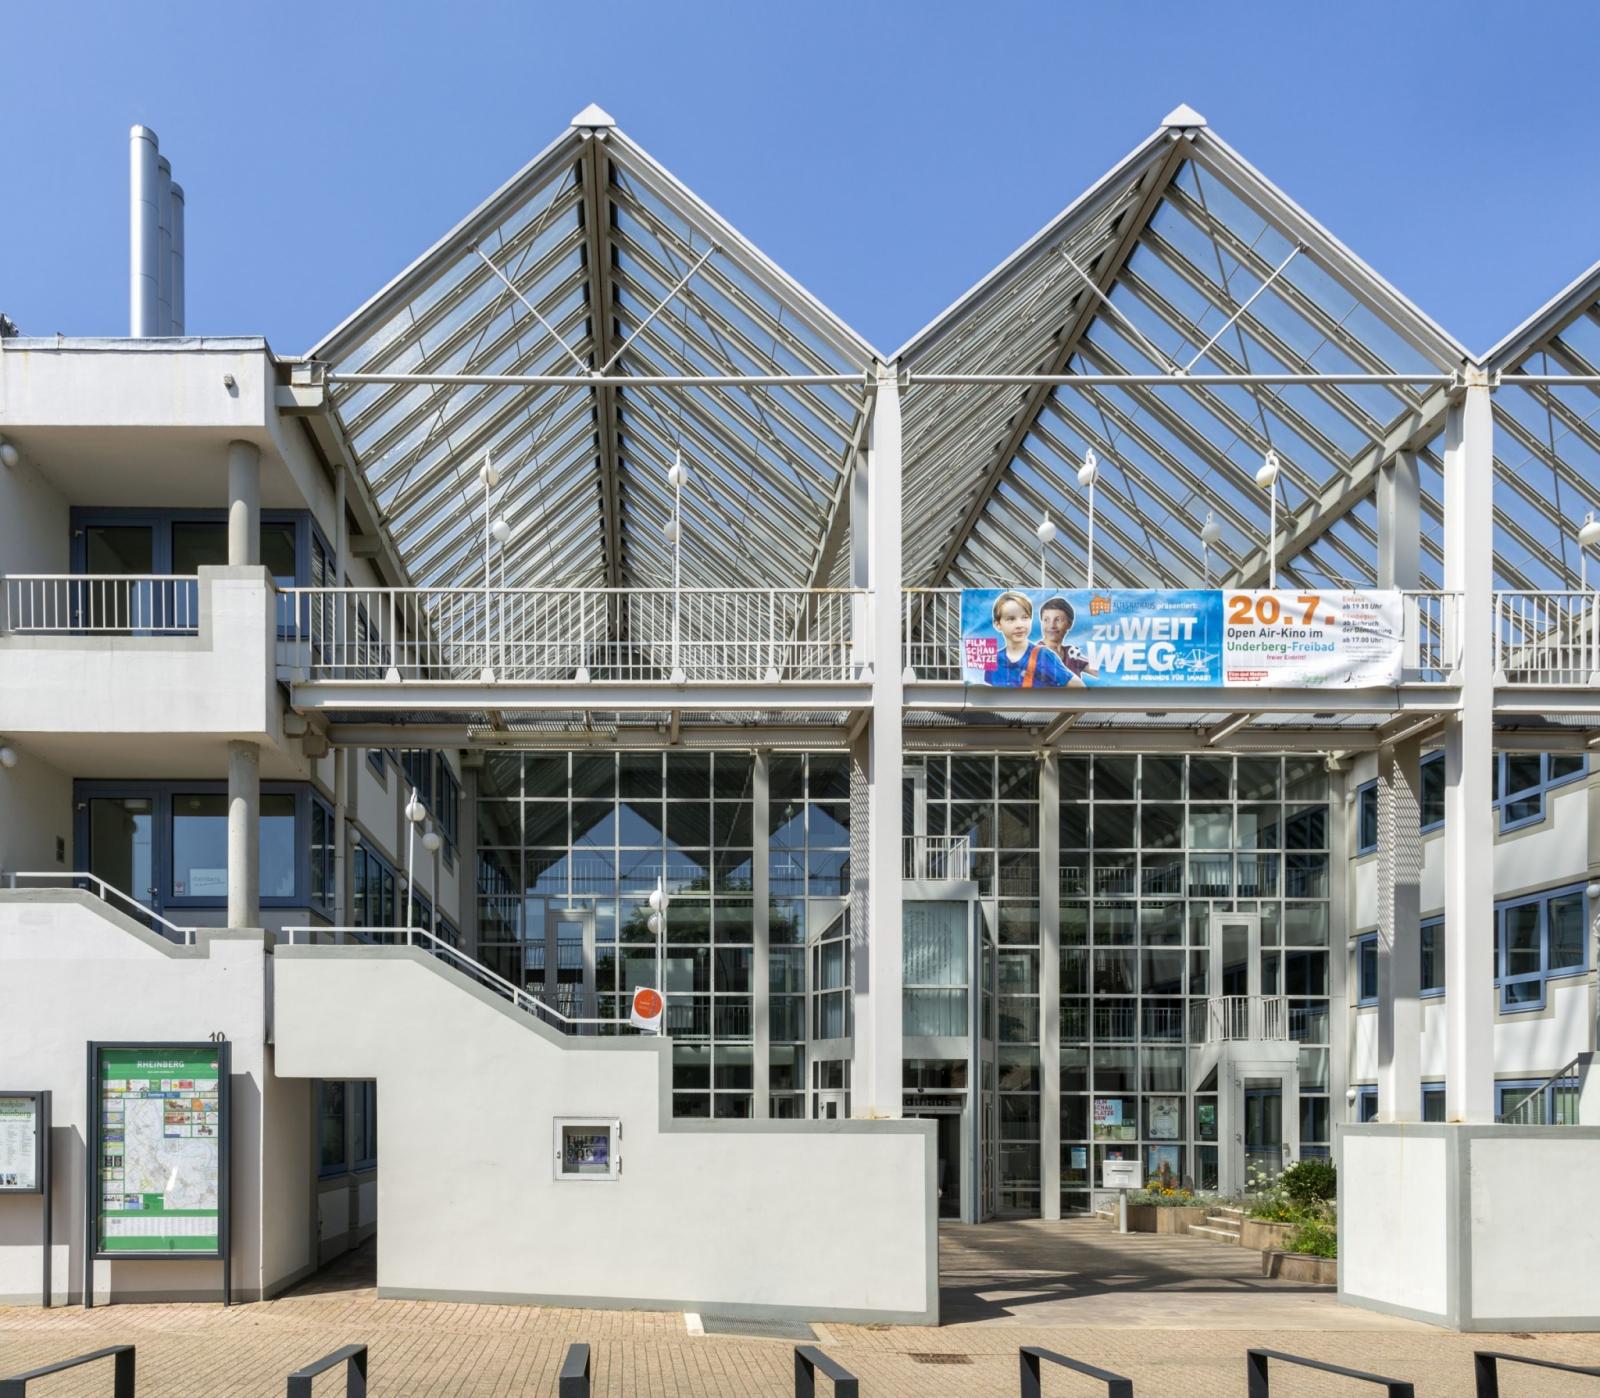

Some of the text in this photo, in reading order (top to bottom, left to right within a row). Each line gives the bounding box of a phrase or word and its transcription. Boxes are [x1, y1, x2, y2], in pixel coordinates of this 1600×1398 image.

[1228, 595, 1335, 625] 20.7.
[1120, 617, 1198, 640] WEIT
[1227, 628, 1323, 640] Open Air-Kino im
[966, 639, 986, 647] FILM
[1227, 642, 1335, 653] Underberg-Freibad
[966, 647, 994, 655] SCHAU
[1086, 641, 1176, 673] WEG
[208, 1031, 226, 1042] 10
[137, 1060, 185, 1068] RHEINBERG
[903, 1095, 953, 1107] dthaus
